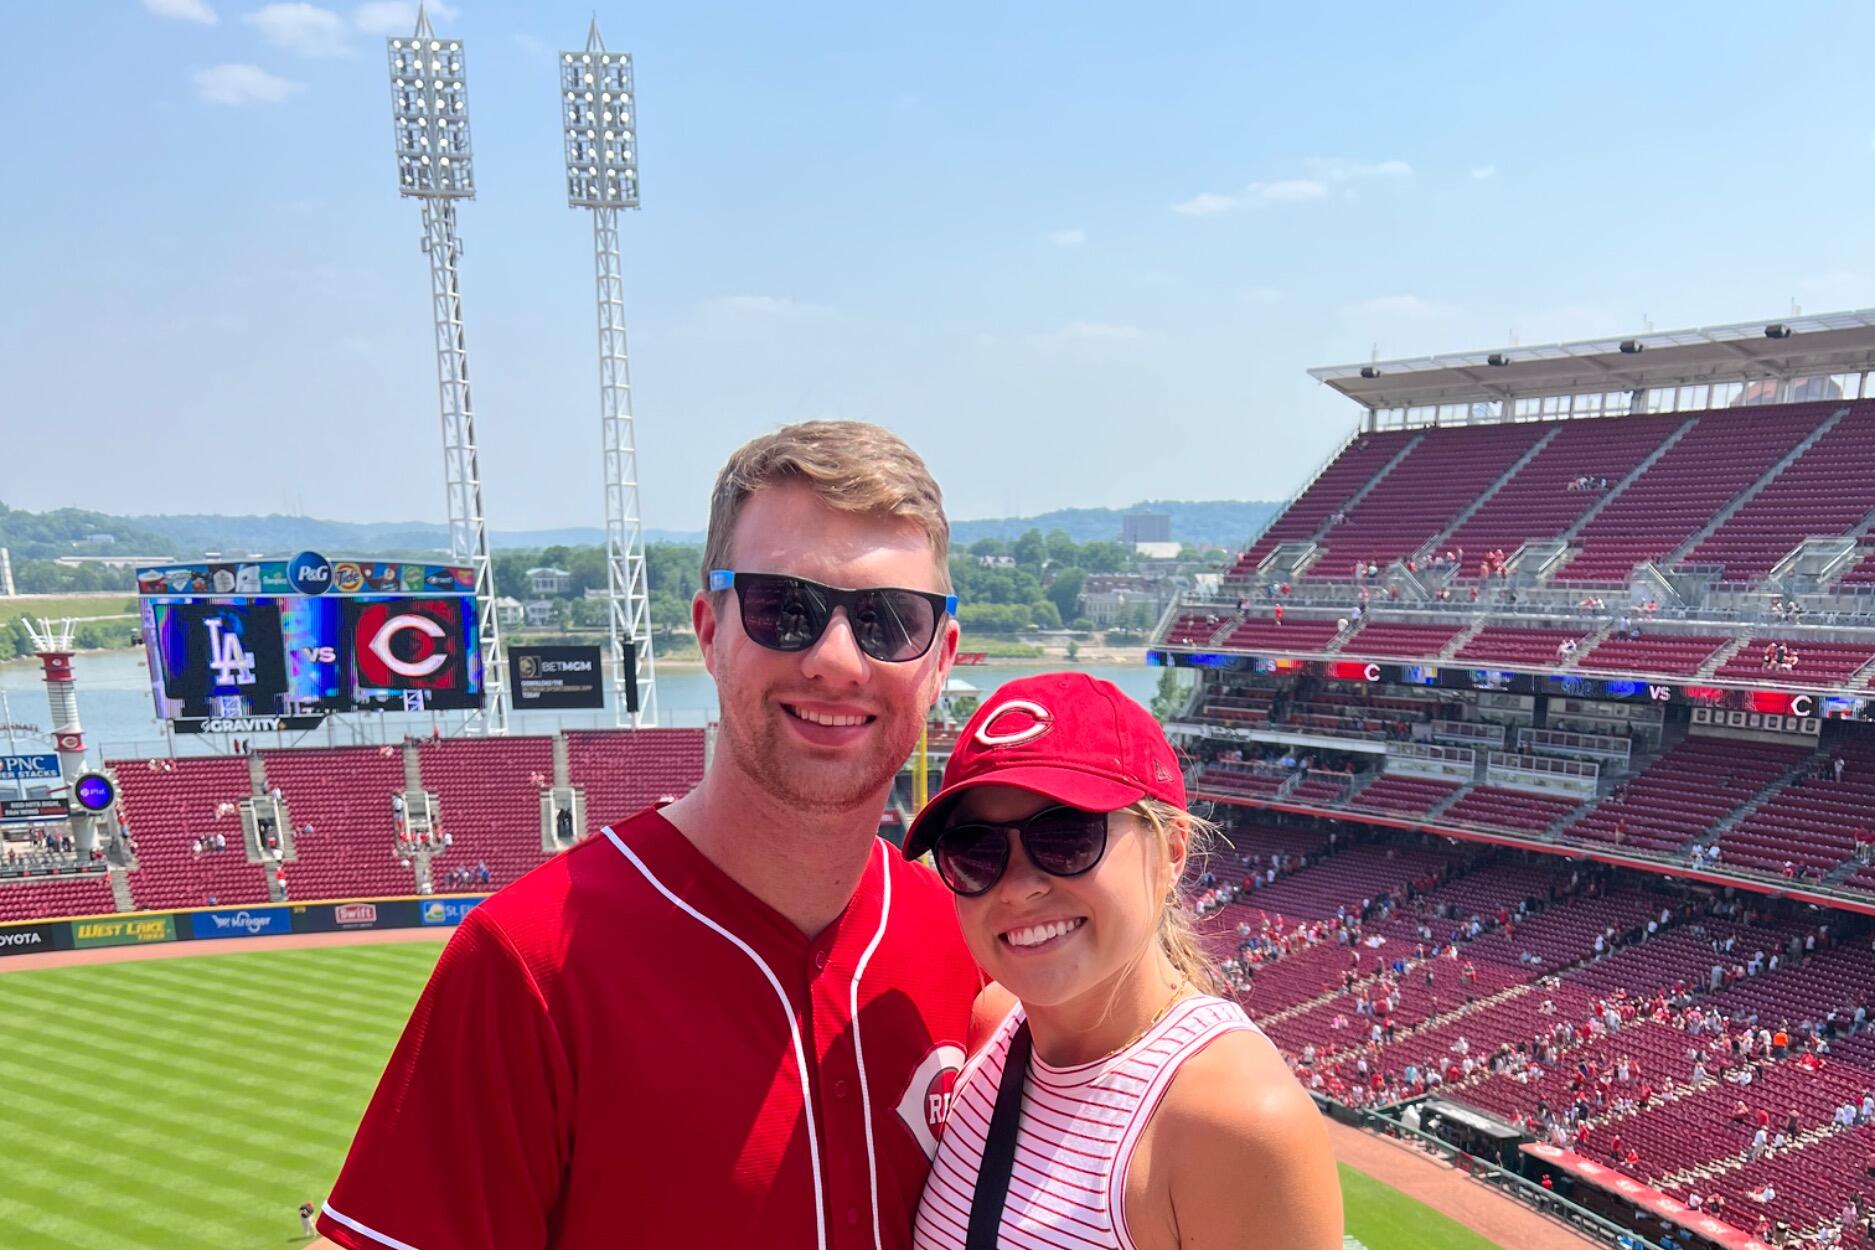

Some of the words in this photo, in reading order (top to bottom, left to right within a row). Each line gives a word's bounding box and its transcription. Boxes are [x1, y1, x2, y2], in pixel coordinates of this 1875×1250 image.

[298, 566, 329, 581] P&G
[203, 616, 255, 686] LA
[541, 661, 592, 672] BETMGM
[1649, 685, 1671, 701] VS
[210, 718, 280, 732] GRAVITY
[975, 700, 1052, 747] C
[4, 756, 45, 771] PNC
